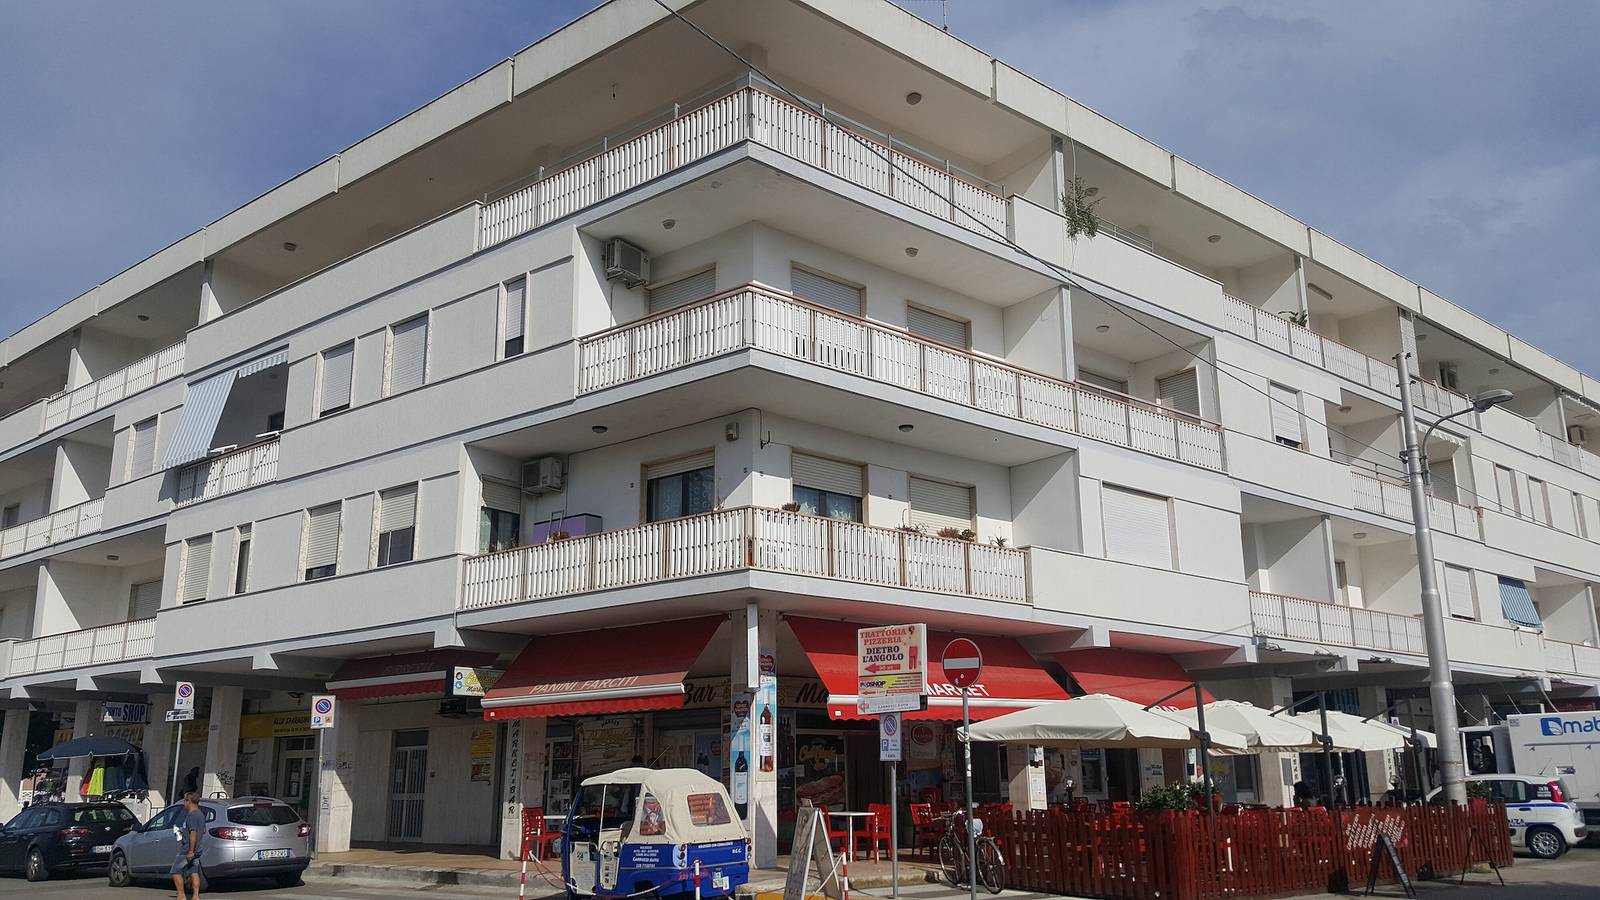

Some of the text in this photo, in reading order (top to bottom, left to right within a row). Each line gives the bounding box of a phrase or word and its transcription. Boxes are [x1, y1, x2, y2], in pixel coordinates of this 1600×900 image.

[860, 628, 907, 639] TRATTORIA
[863, 636, 902, 646] PIZZERIA
[862, 653, 904, 663] L'ANGOLO
[866, 645, 900, 655] DIETRO
[529, 676, 639, 695] PANINI FARCITI
[684, 683, 717, 705] Bar
[122, 704, 146, 722] SHOP
[510, 719, 521, 777] MARKET
[507, 785, 517, 814] BAR
